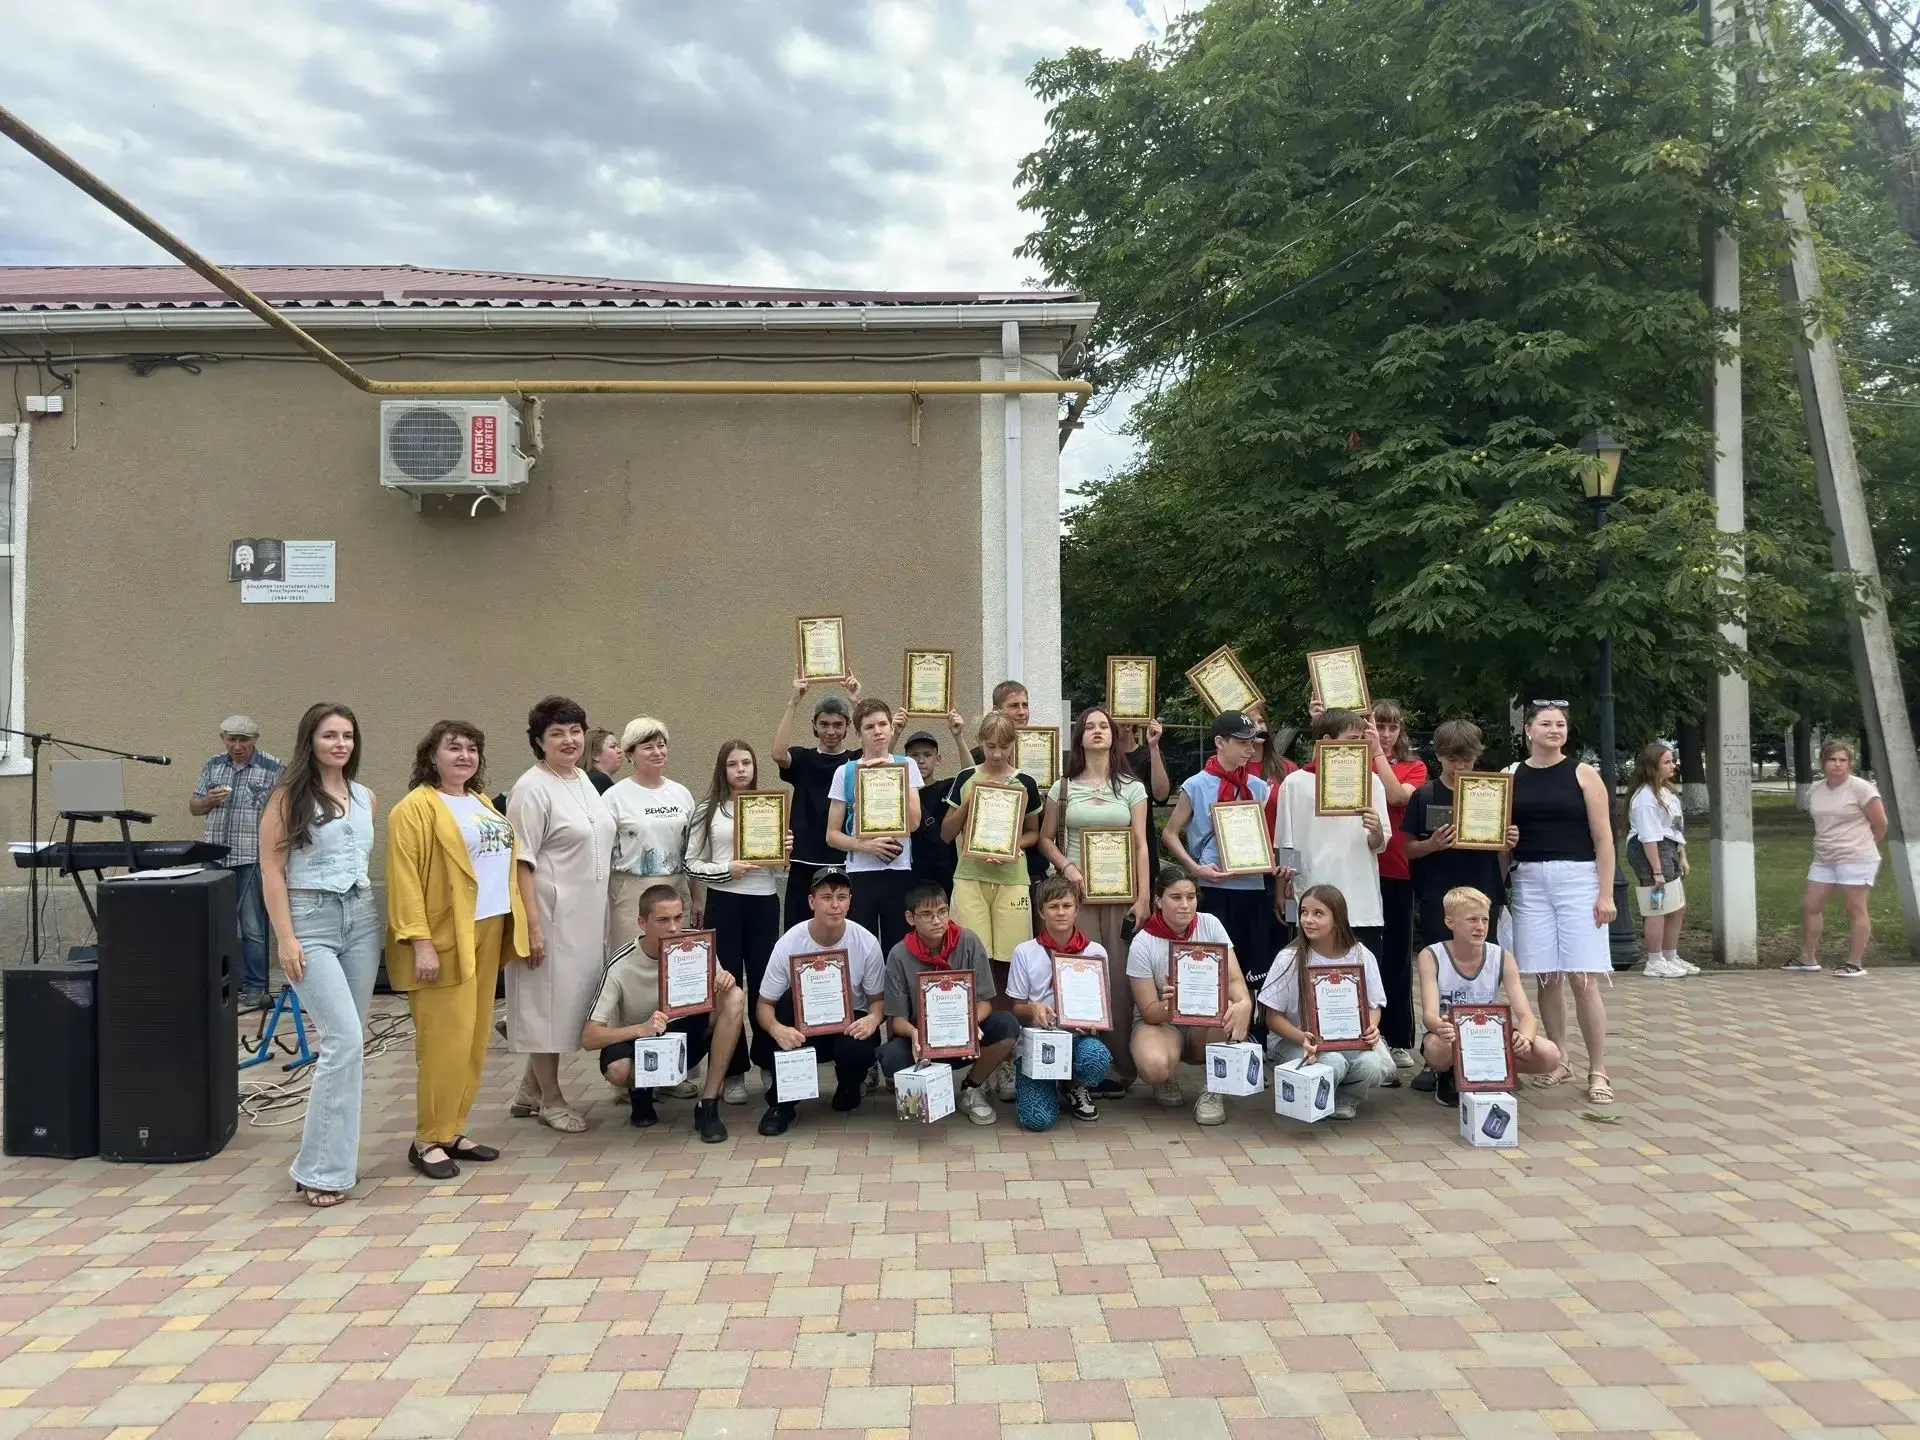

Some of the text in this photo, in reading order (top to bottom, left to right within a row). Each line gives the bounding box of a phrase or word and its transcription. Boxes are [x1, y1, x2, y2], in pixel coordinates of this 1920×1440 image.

[485, 418, 493, 472] DC INVERTER
[475, 429, 483, 472] CENTEK
[1184, 962, 1213, 970] Грамота
[807, 973, 836, 983] Грамота
[1321, 987, 1352, 995] Грамота
[932, 994, 962, 1002] Грамота
